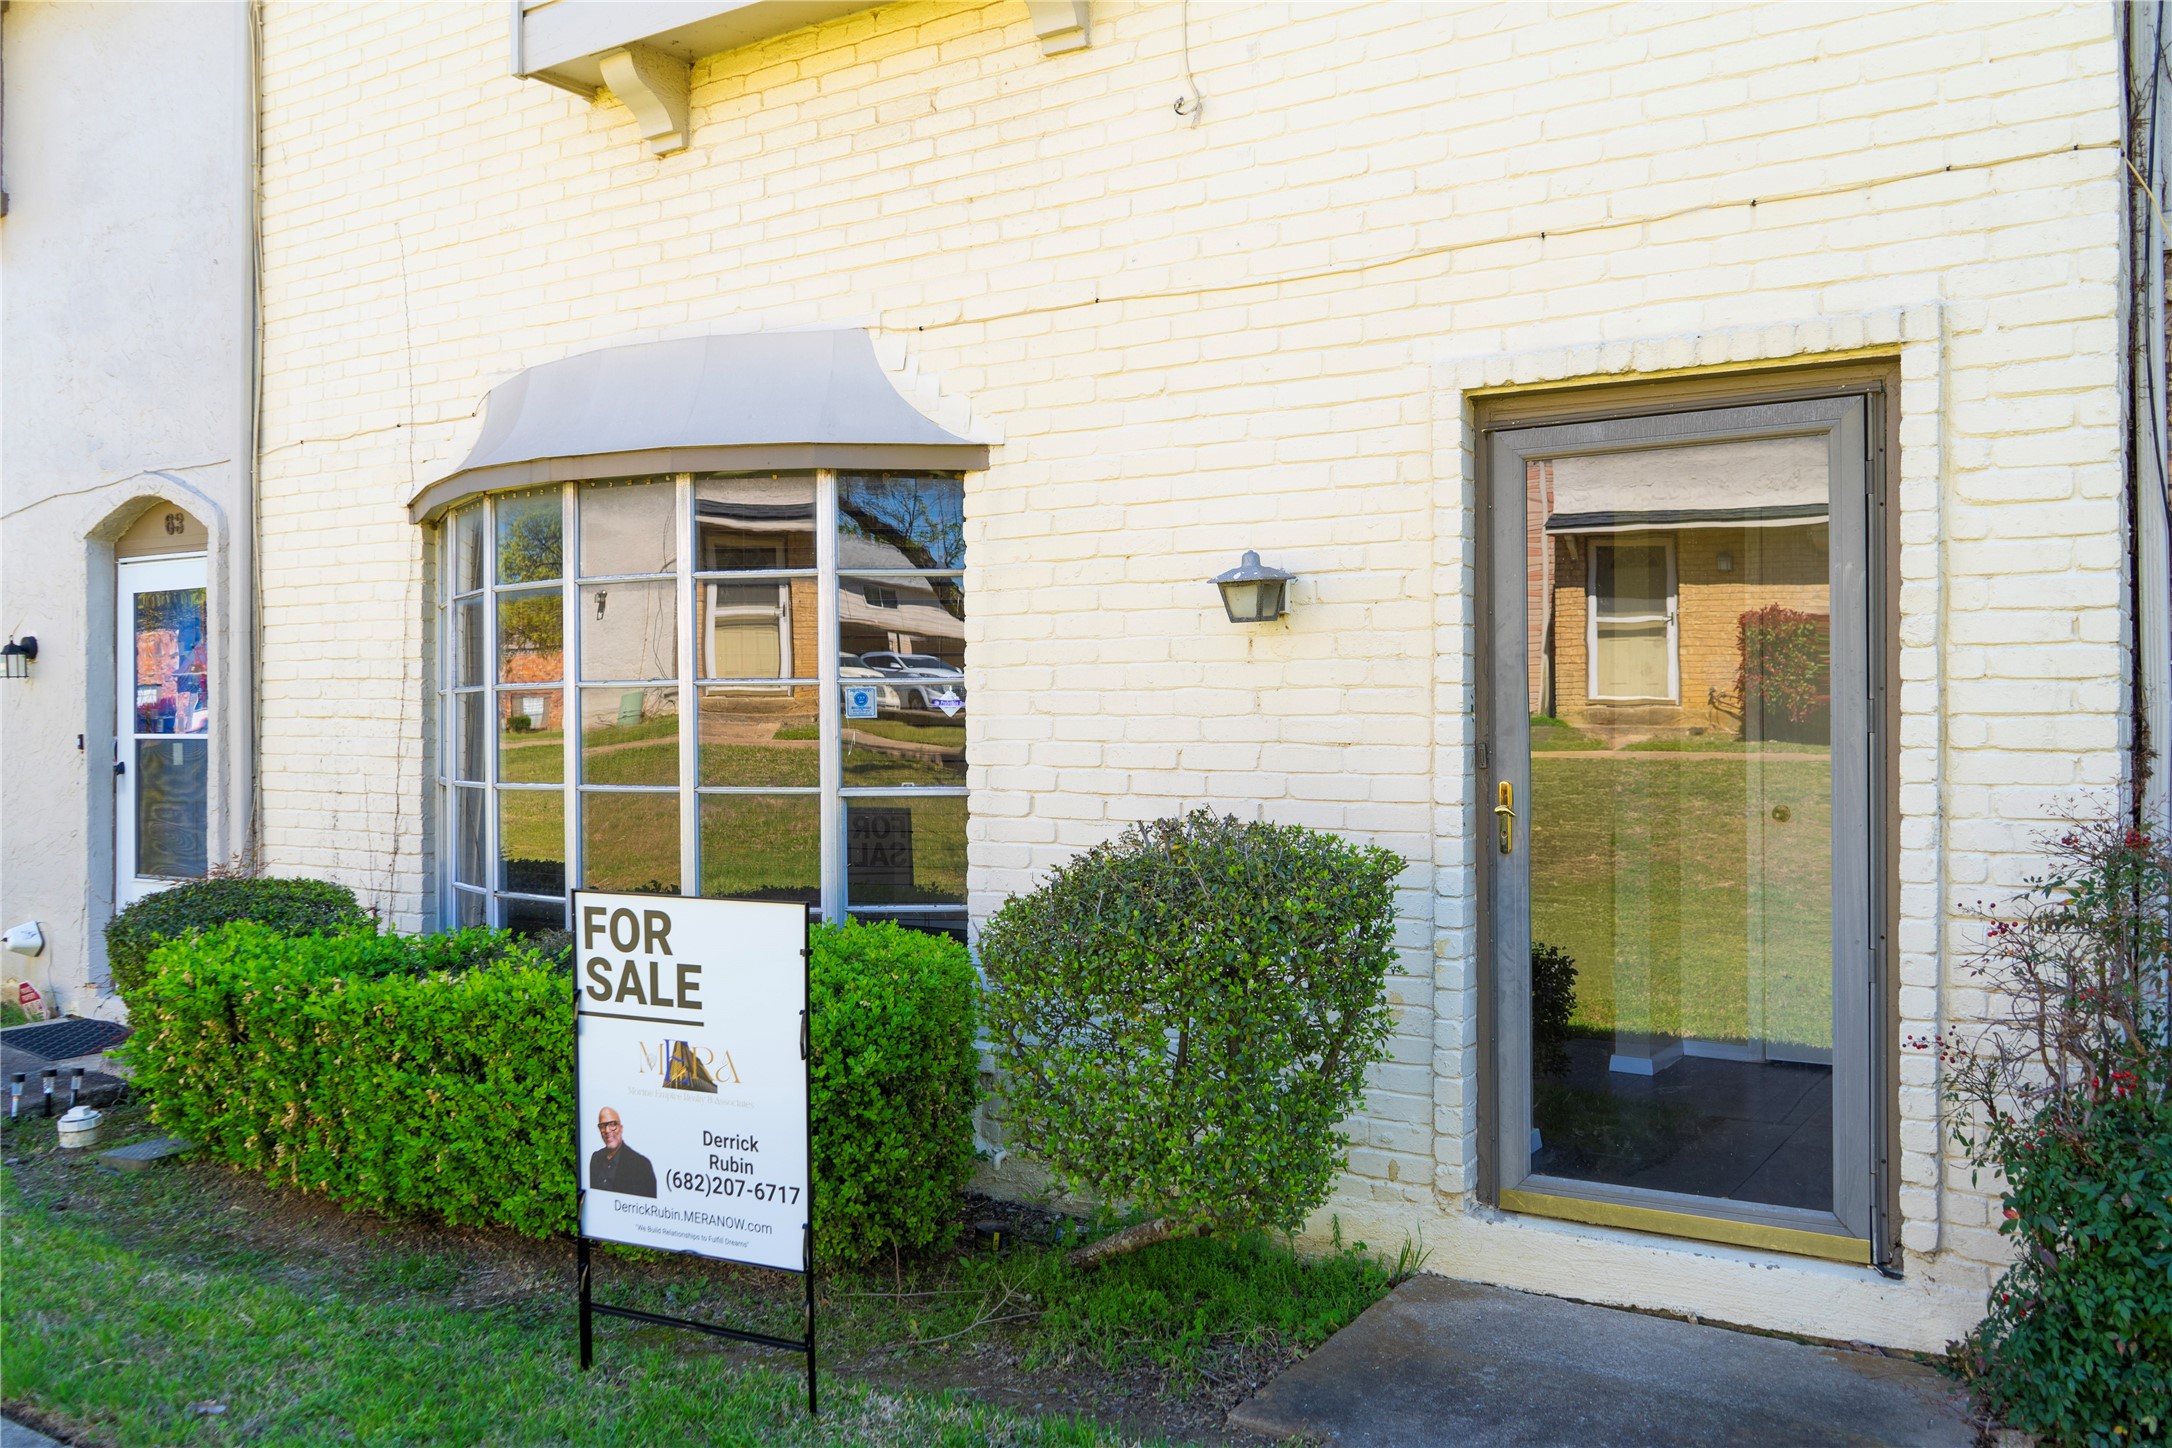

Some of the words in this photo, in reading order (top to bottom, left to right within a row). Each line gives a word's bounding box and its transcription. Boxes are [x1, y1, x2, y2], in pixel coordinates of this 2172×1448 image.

[165, 513, 184, 535] 63
[583, 906, 673, 956] FOR
[586, 956, 703, 1010] SALE
[638, 1038, 741, 1084] MERA
[703, 1130, 759, 1152] Derrick
[709, 1154, 754, 1175] Rubin
[666, 1168, 800, 1205] (682)207-6717
[614, 1199, 773, 1235] DerrickRubin.MERANOW.com
[647, 1226, 662, 1234] Build
[662, 1228, 700, 1241] Relationships
[701, 1234, 708, 1242] to
